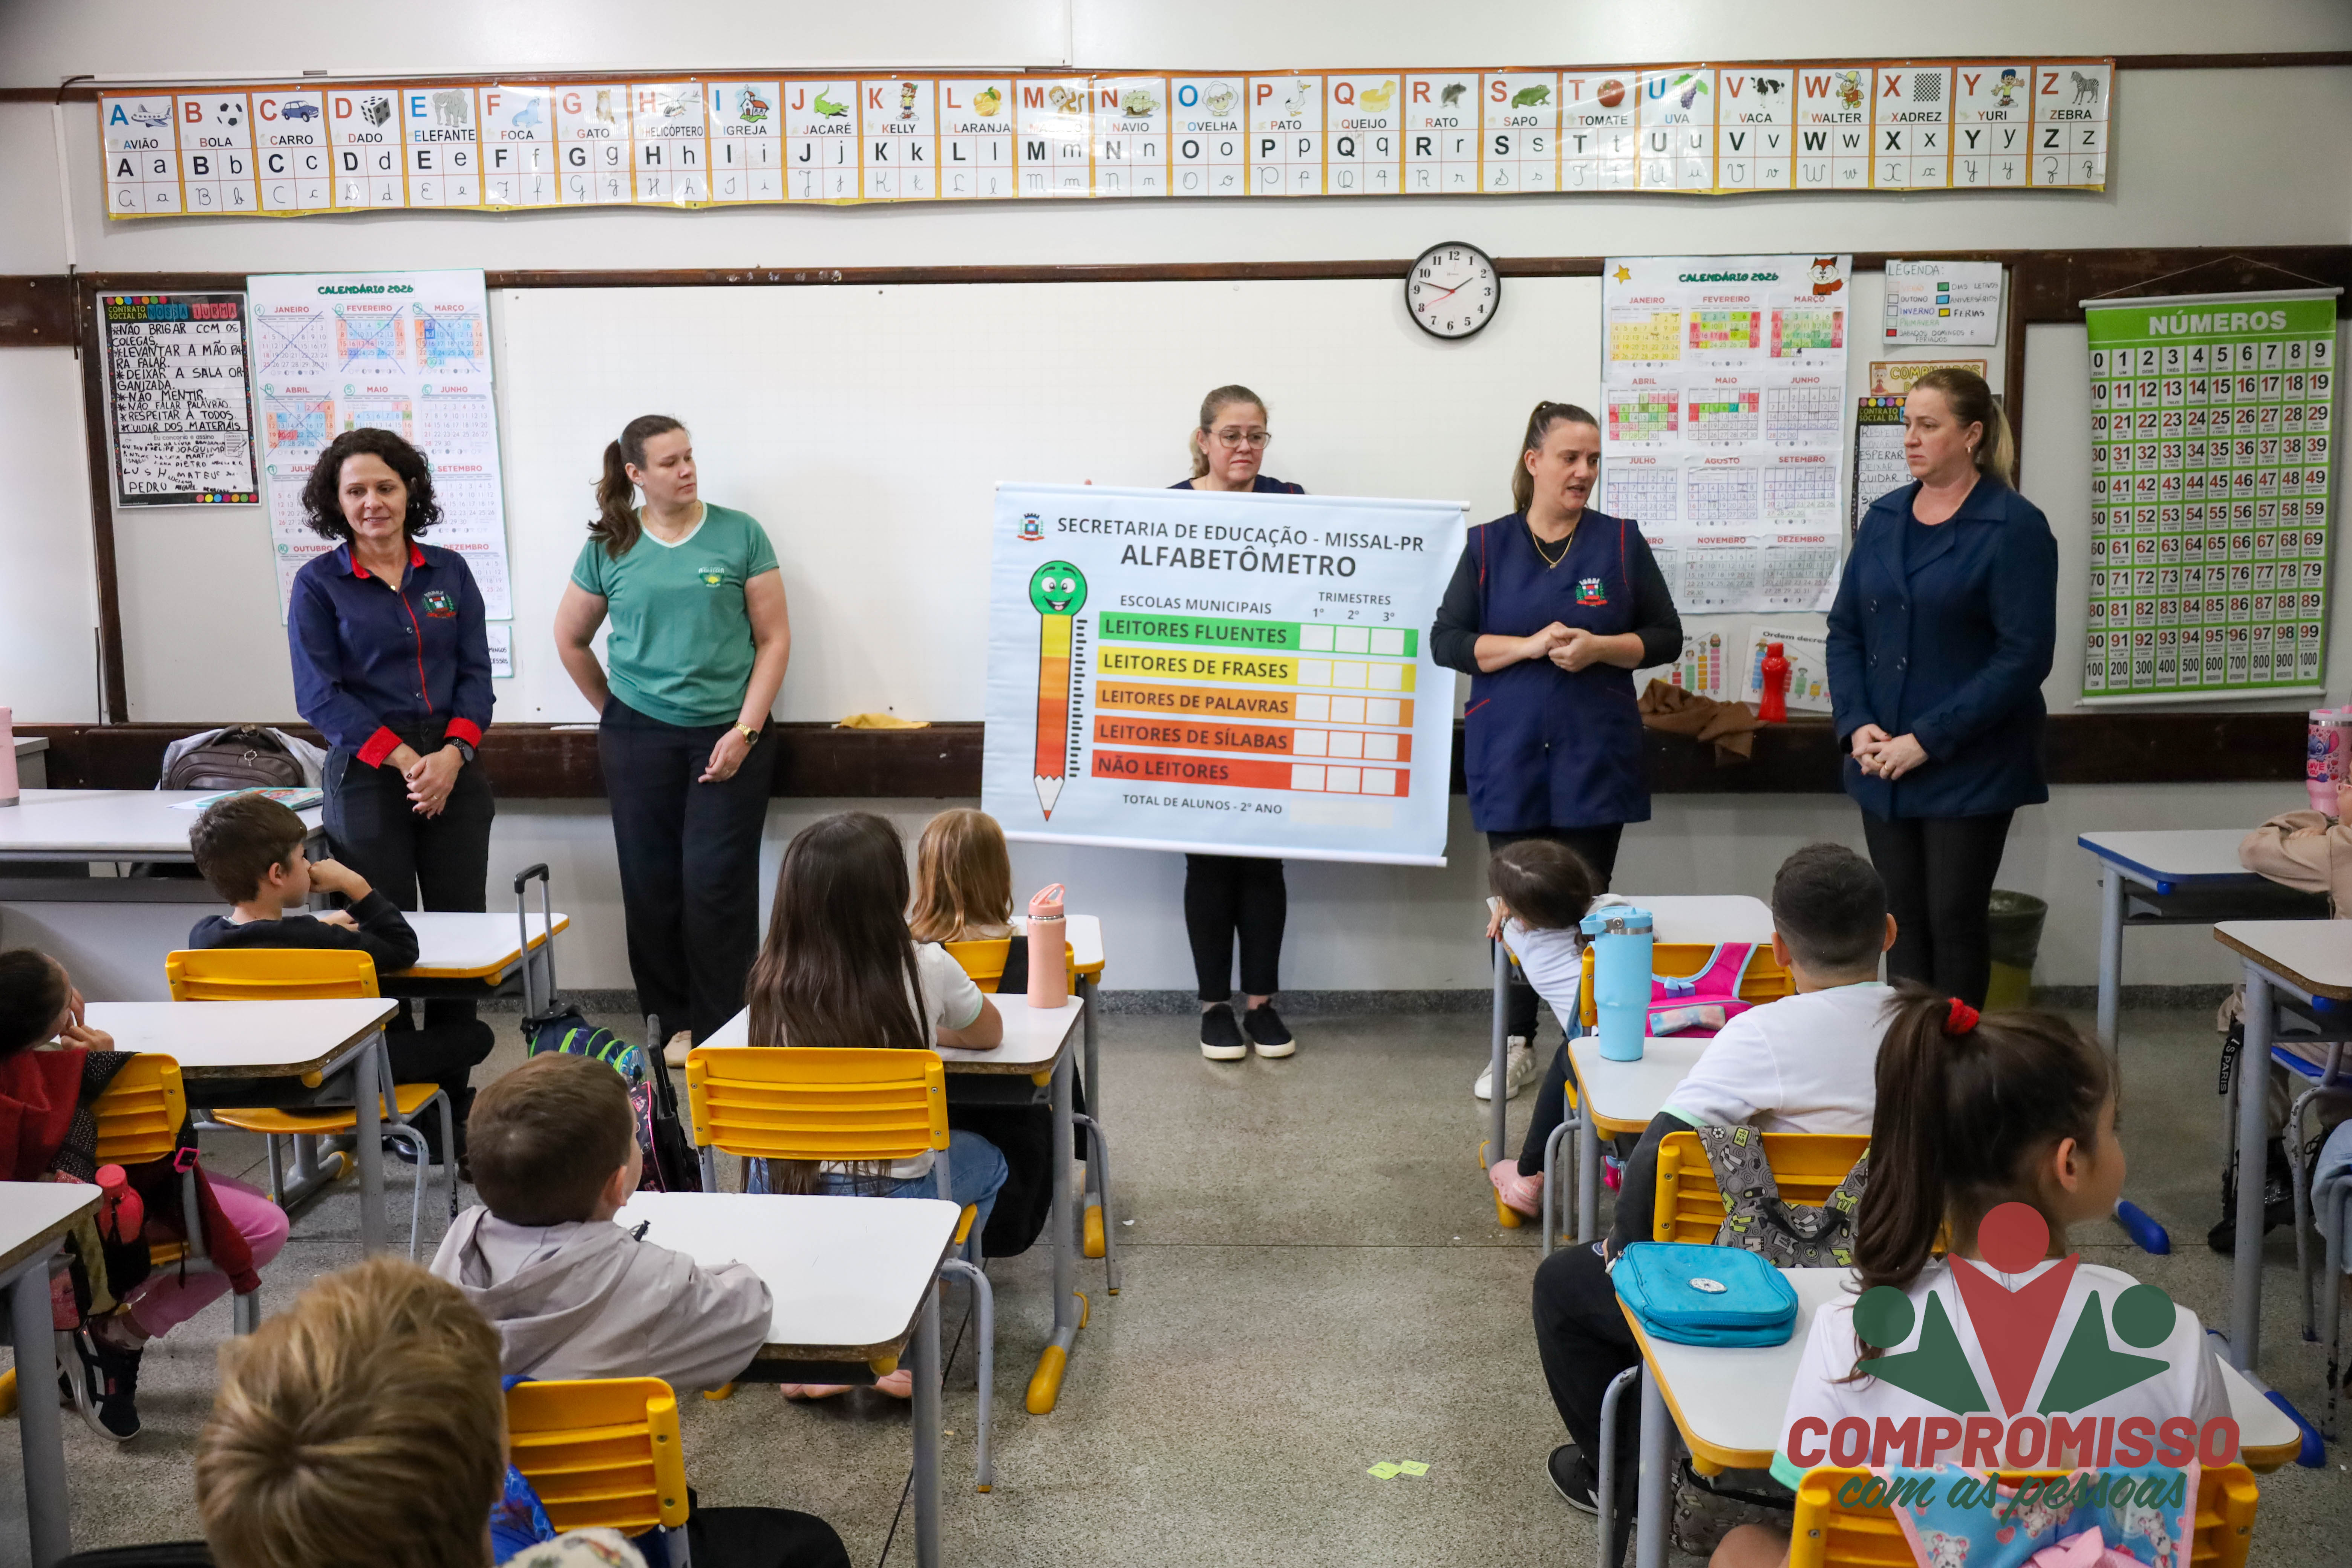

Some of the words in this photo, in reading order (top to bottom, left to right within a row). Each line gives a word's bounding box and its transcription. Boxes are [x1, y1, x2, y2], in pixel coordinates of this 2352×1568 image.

[1664, 114, 1689, 124] UVA
[1740, 113, 1772, 122] VACA
[1812, 113, 1861, 122] WALTER
[1892, 112, 1941, 122] XADREZ
[1978, 111, 2006, 121] YURI
[2050, 110, 2092, 119] ZEBRA
[1271, 120, 1301, 130] PATO
[1342, 119, 1386, 129] QUEIJO
[1426, 118, 1458, 127] RATO
[1504, 116, 1537, 126] SAPO
[1579, 116, 1627, 125] TOMATE
[645, 125, 703, 136] HELICÓPTERO
[723, 126, 767, 135] IGREJA
[804, 122, 851, 134] JACARÉ
[882, 124, 915, 133] KELLY
[954, 124, 1011, 133] LARANJA
[1113, 122, 1149, 132] NAVIO
[1188, 122, 1237, 131] OVELHA
[349, 133, 382, 142] DADO
[415, 130, 475, 141] ELEFANTE
[501, 130, 533, 139] FOCA
[577, 129, 609, 138] GATO
[124, 138, 158, 149] AVIÃO
[200, 138, 232, 147] BOLA
[271, 135, 313, 145] CARRO
[1433, 256, 1441, 265] 11
[1449, 251, 1459, 260] 12
[1469, 256, 1473, 265] 1
[1419, 268, 1430, 277] 10
[1481, 269, 1486, 278] 2
[1888, 264, 1944, 276] LEGENDA:
[1679, 271, 1749, 282] CALENDÁRIO
[1751, 273, 1779, 281] 2026
[318, 283, 384, 294] CALENDÁRIO
[387, 285, 413, 293] 2026
[1413, 285, 1420, 294] 9
[1484, 287, 1491, 296] 3
[148, 306, 187, 318] NOSSA
[194, 306, 236, 317] TURMA
[1418, 303, 1424, 312] 8
[1478, 305, 1484, 313] 4
[1431, 316, 1436, 325] 7
[1447, 321, 1453, 330] 6
[1465, 317, 1471, 326] 5
[2149, 309, 2286, 335] NÚMEROS
[120, 323, 140, 335] NÃO
[149, 323, 187, 335] BRIGAR
[123, 344, 180, 357] LEVANTAR
[188, 344, 196, 356] A
[203, 340, 226, 356] MÃO
[2241, 345, 2253, 361] 6
[2267, 345, 2277, 360] 7
[2290, 343, 2301, 359] 8
[2314, 341, 2326, 358] 9
[2119, 352, 2126, 366] 1
[2144, 351, 2153, 365] 2
[2168, 349, 2178, 364] 3
[2193, 348, 2203, 362] 4
[2218, 347, 2228, 361] 5
[116, 358, 130, 369] RA
[2094, 352, 2104, 368] 0
[127, 368, 166, 380] DEIXAR
[176, 367, 184, 378] A
[193, 367, 222, 378] SALA
[129, 390, 151, 401] NÃO
[156, 401, 181, 410] FALAR
[129, 410, 180, 421] RESPEITAR
[165, 422, 183, 432] DOS
[1860, 450, 1903, 460] ESPERAR
[1629, 456, 1656, 465] JULHO
[1859, 473, 1899, 483] CUIDAR
[1058, 518, 1168, 537] SECRETARIA
[1175, 524, 1197, 538] DE
[1204, 525, 1306, 547] EDUCAÇÃO
[1326, 533, 1423, 551] MISSAL-PR
[1121, 544, 1356, 577] ALFABETÔMETRO
[1319, 592, 1390, 605] TRIMESTRES
[1121, 595, 1181, 609] ESCOLAS
[1186, 599, 1271, 615] MUNICIPAIS
[1105, 619, 1189, 638] LEITORES
[1195, 623, 1287, 644] FLUENTES
[1763, 631, 1795, 640] Ordem
[1103, 654, 1187, 672] LEITORES
[1194, 660, 1216, 674] DE
[1222, 662, 1288, 678] FRASES
[1102, 690, 1174, 706] LEITORES
[1181, 695, 1199, 707] DE
[1205, 697, 1288, 713] PALAVRAS
[1100, 726, 1181, 742] LEITORES
[1187, 730, 1208, 744] DE
[1214, 725, 1288, 749] SÍLABAS
[1099, 754, 1139, 773] NÃO
[1145, 761, 1229, 779] LEITORES
[1123, 795, 1159, 805] TOTAL
[1164, 797, 1178, 807] DE
[1181, 798, 1230, 810] ALUNOS
[1255, 804, 1282, 814] ANO
[2220, 1056, 2231, 1091] PARIS
[1839, 1198, 1851, 1211] 17
